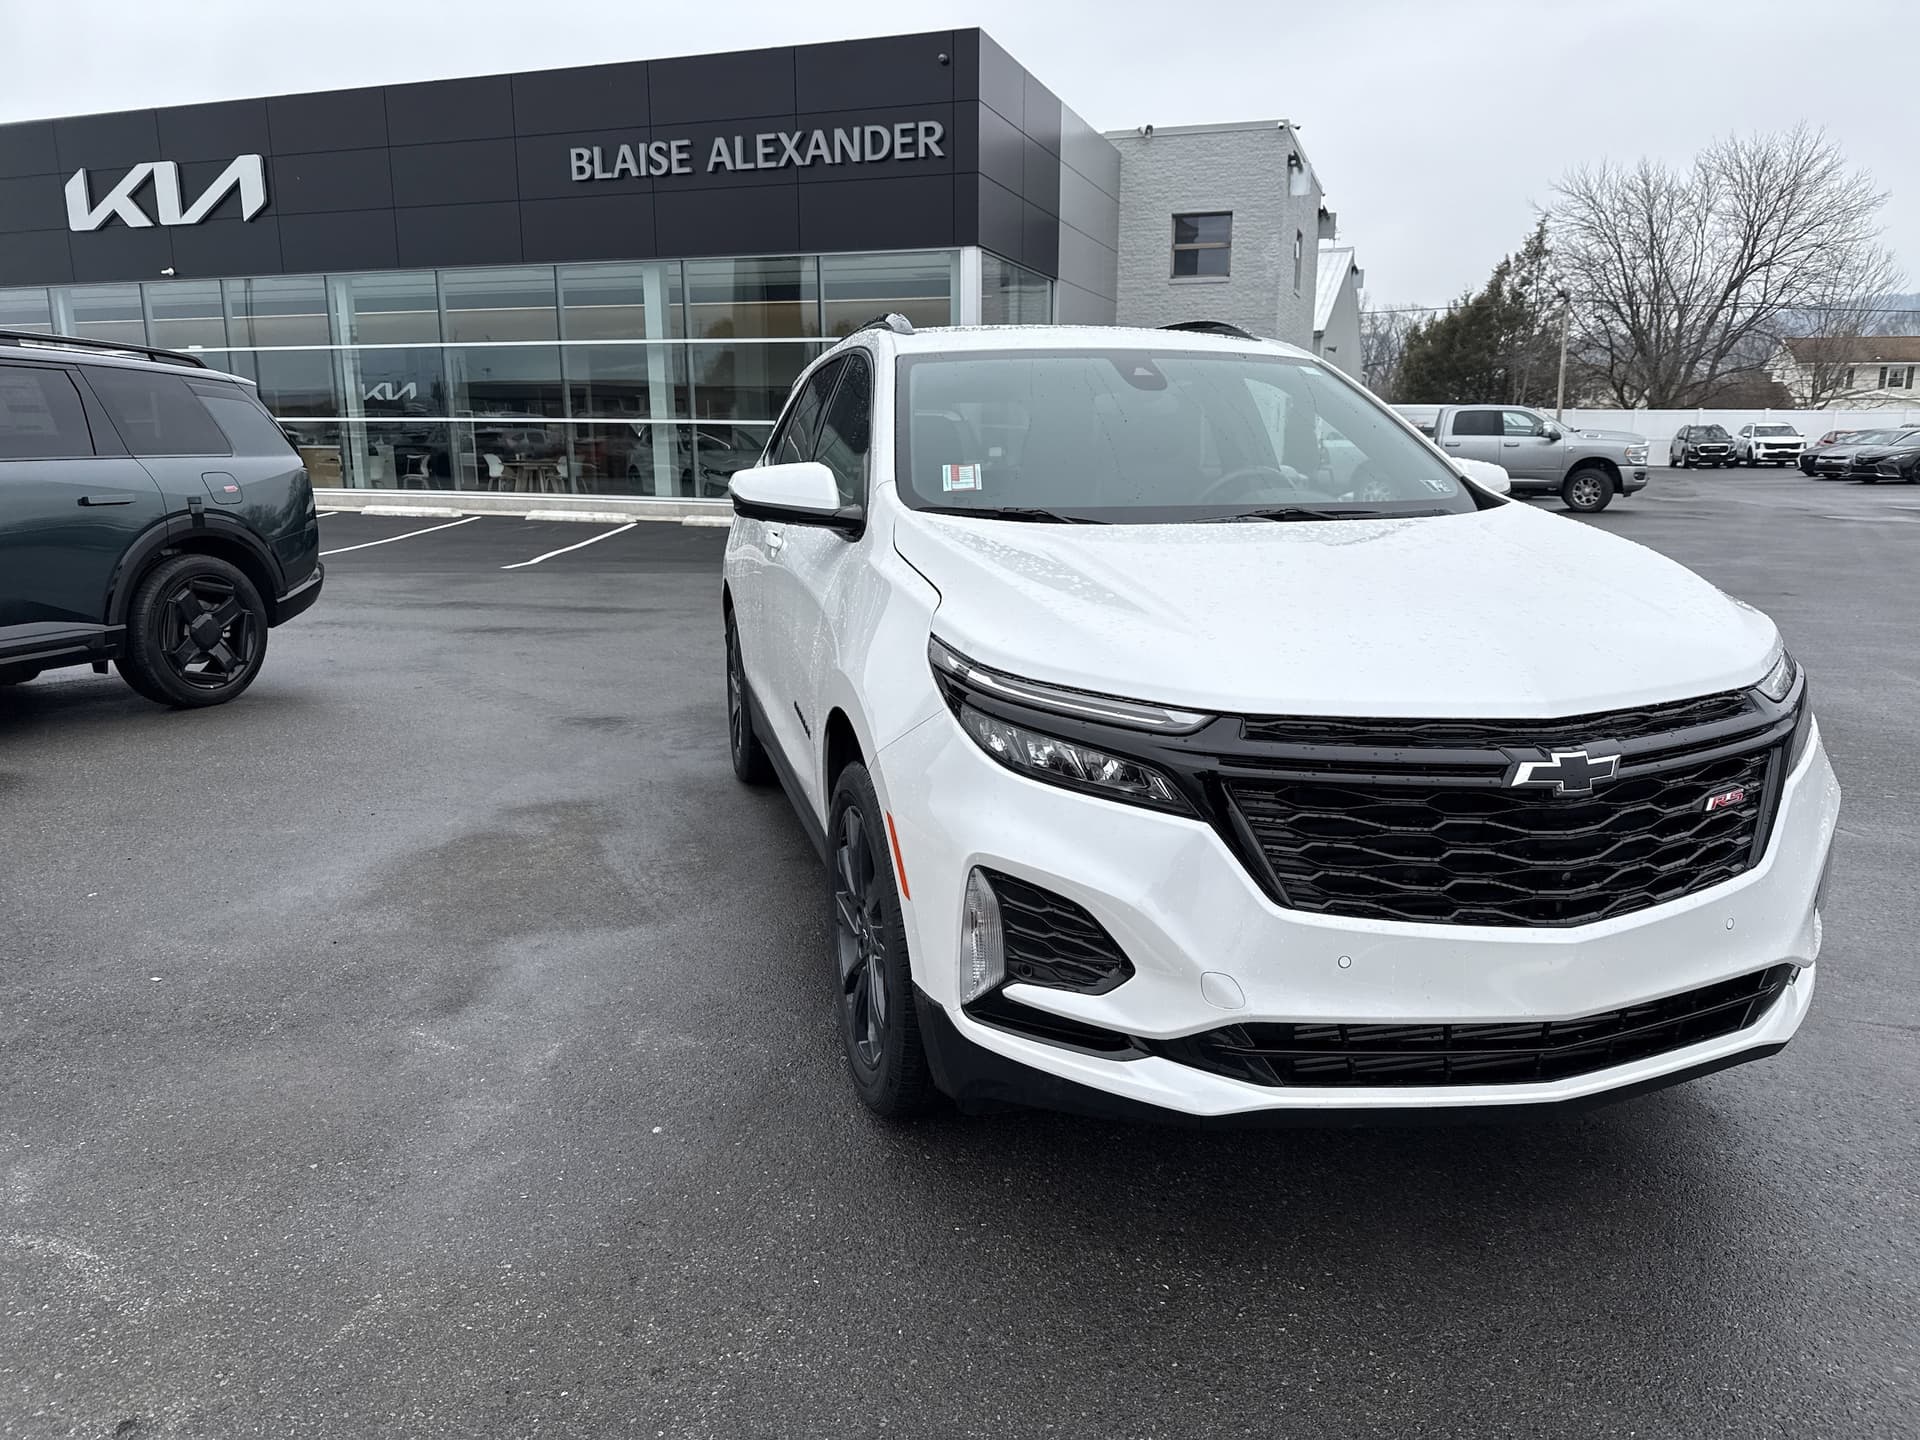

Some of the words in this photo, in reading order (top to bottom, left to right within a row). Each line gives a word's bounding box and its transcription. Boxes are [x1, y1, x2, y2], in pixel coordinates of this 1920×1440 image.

[570, 139, 692, 181] BLAISE
[706, 120, 945, 172] ALEXANDER
[65, 154, 266, 231] KIA
[362, 382, 416, 400] KIA
[1706, 788, 1744, 811] RS
